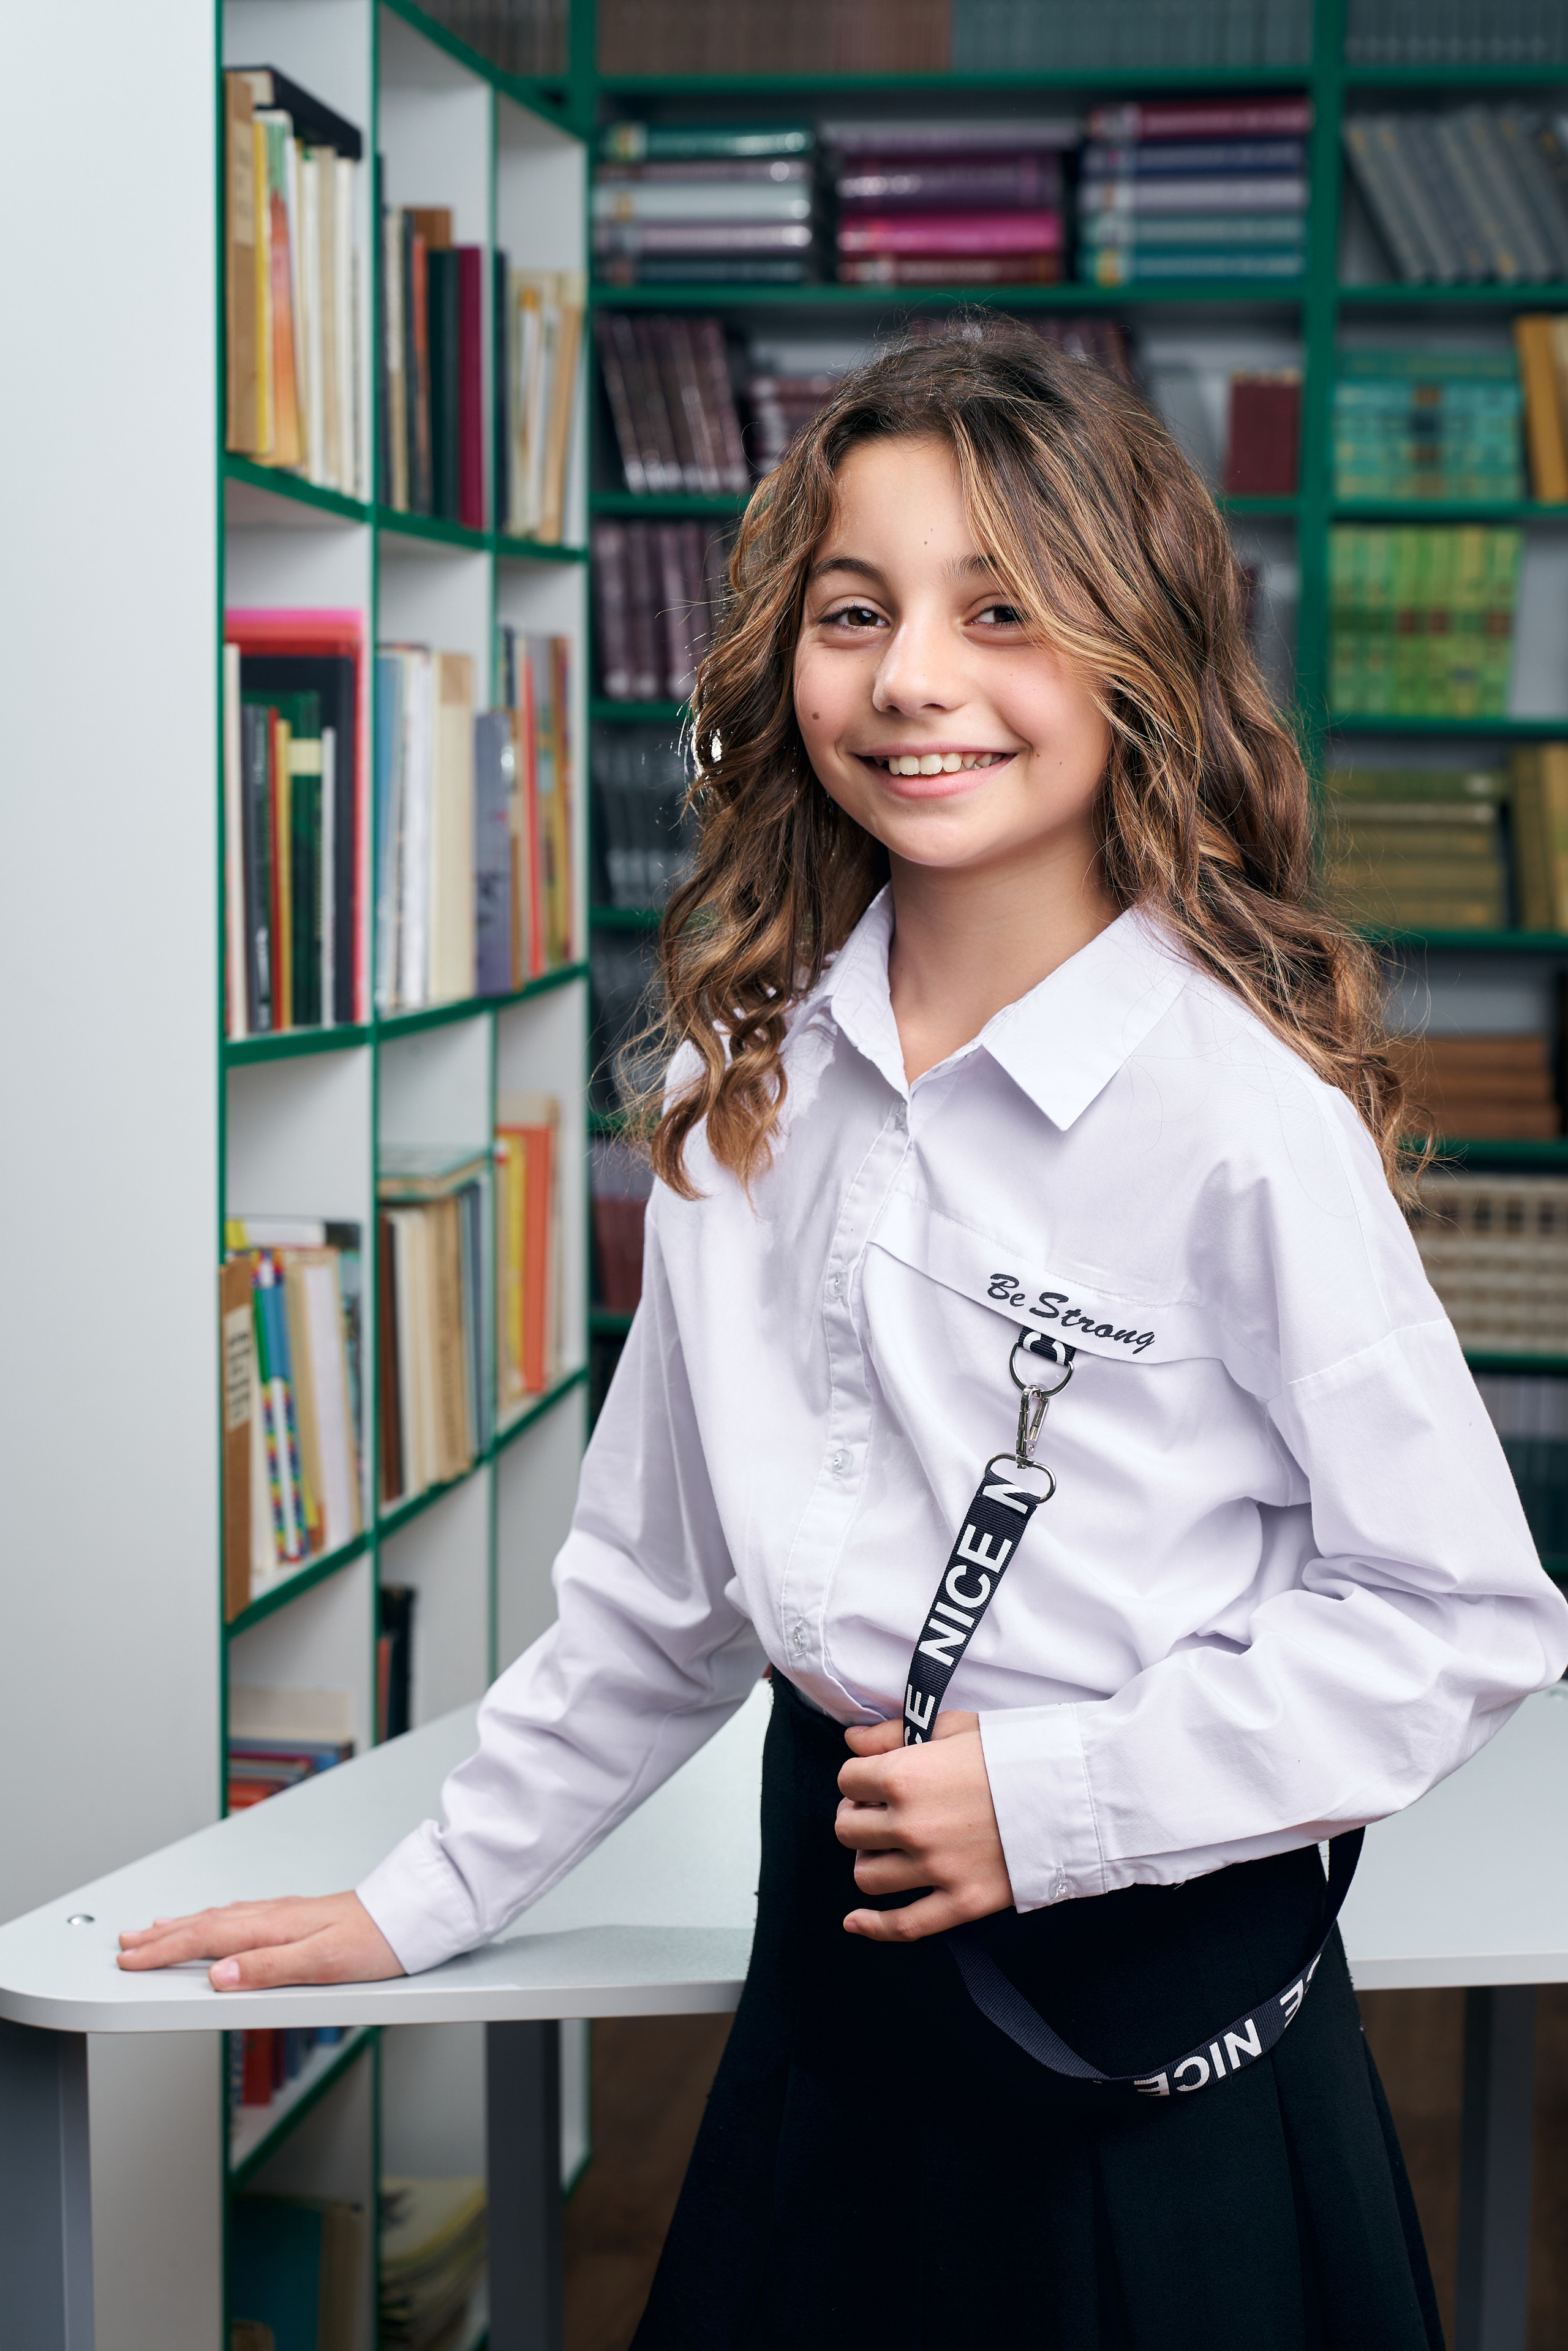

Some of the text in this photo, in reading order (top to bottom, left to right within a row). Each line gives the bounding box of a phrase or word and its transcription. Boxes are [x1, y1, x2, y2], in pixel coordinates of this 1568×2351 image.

[987, 1274, 1026, 1307] Be
[1029, 1292, 1155, 1354] Strong
[919, 1523, 1013, 1667] NICE
[1134, 2018, 1262, 2096] NICE
